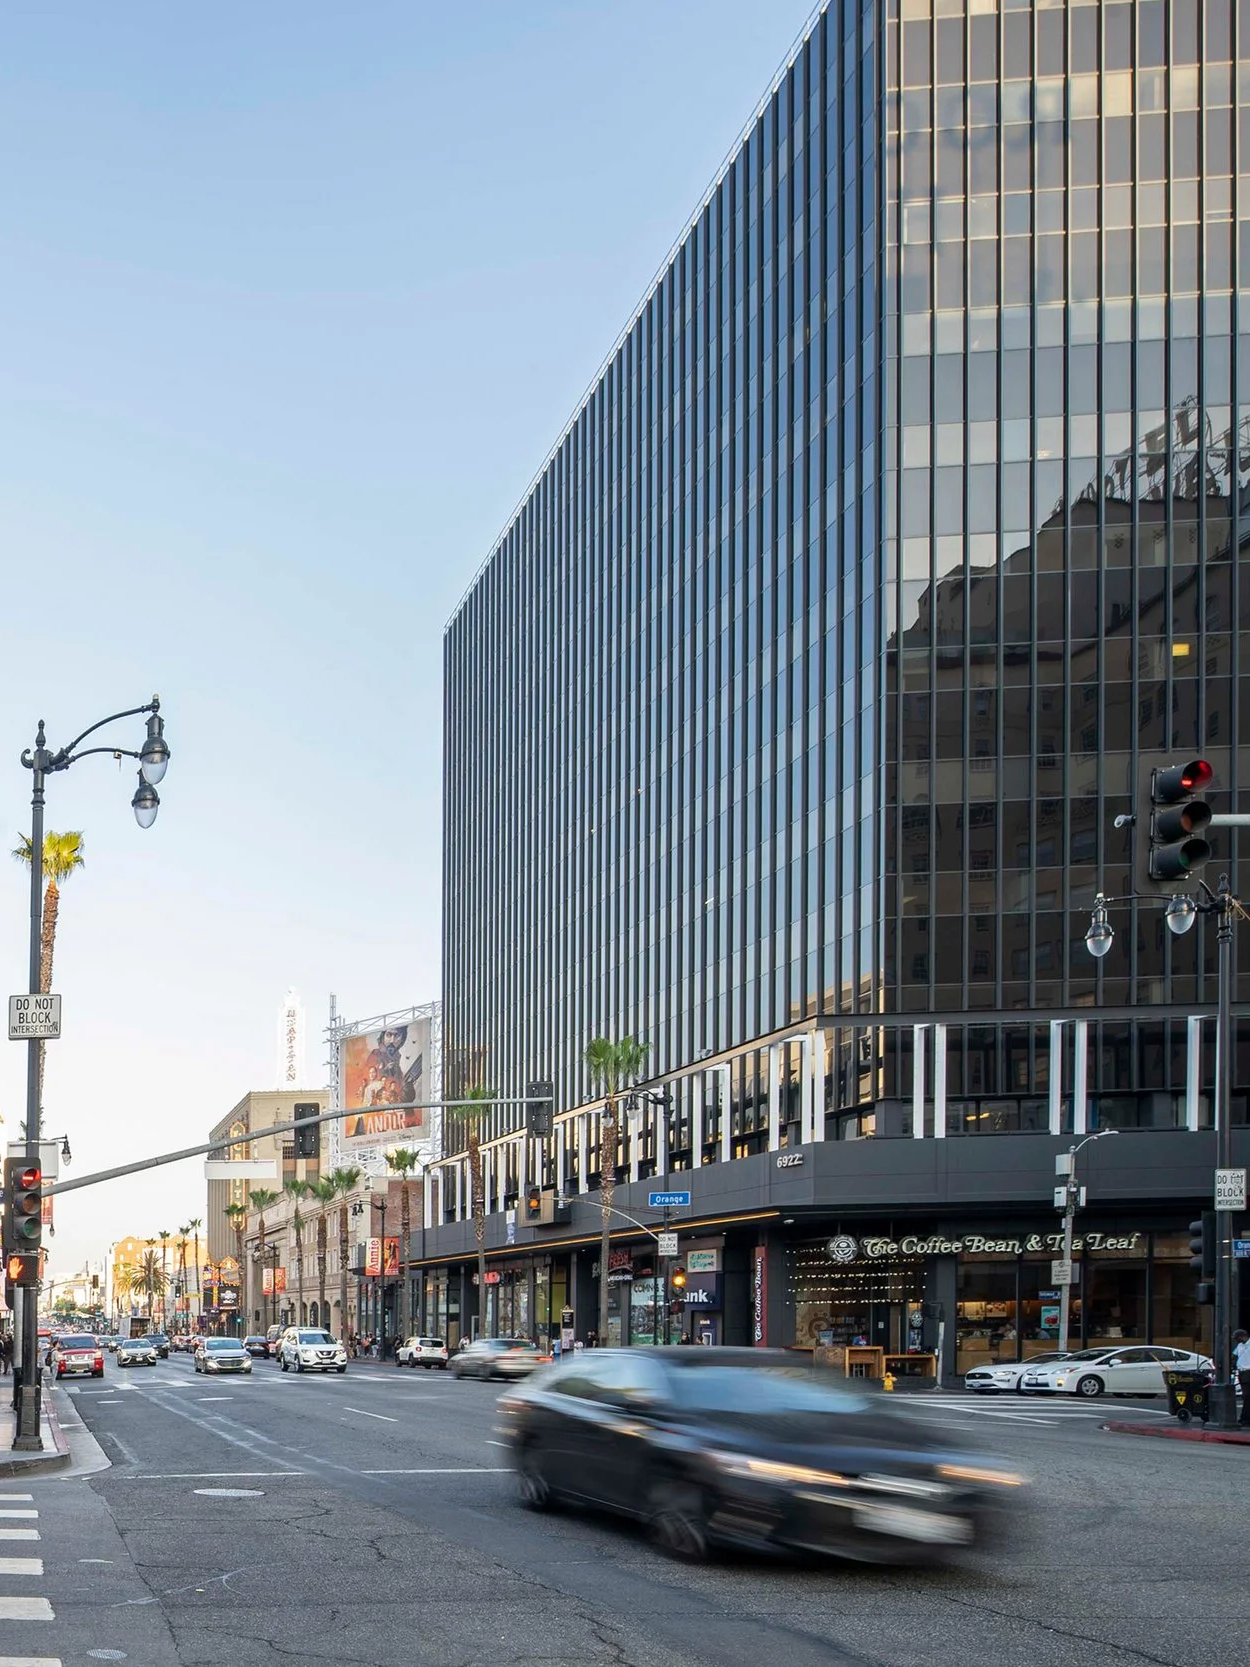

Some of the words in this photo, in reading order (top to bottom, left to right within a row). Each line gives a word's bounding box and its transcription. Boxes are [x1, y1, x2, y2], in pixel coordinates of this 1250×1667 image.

[16, 998, 30, 1011] DO
[34, 997, 54, 1010] NOT
[18, 1012, 51, 1024] BLOCK
[11, 1024, 58, 1034] INTERSECTION
[777, 1153, 803, 1168] 6922
[1217, 1175, 1227, 1185] DO
[1217, 1188, 1244, 1197] BLOCK
[655, 1195, 684, 1204] Orange
[863, 1237, 898, 1257] The
[902, 1236, 962, 1254] Coffee
[964, 1235, 1023, 1254] Bean
[1026, 1234, 1044, 1251] &
[1086, 1233, 1141, 1250] Leaf
[370, 1240, 379, 1272] Annie
